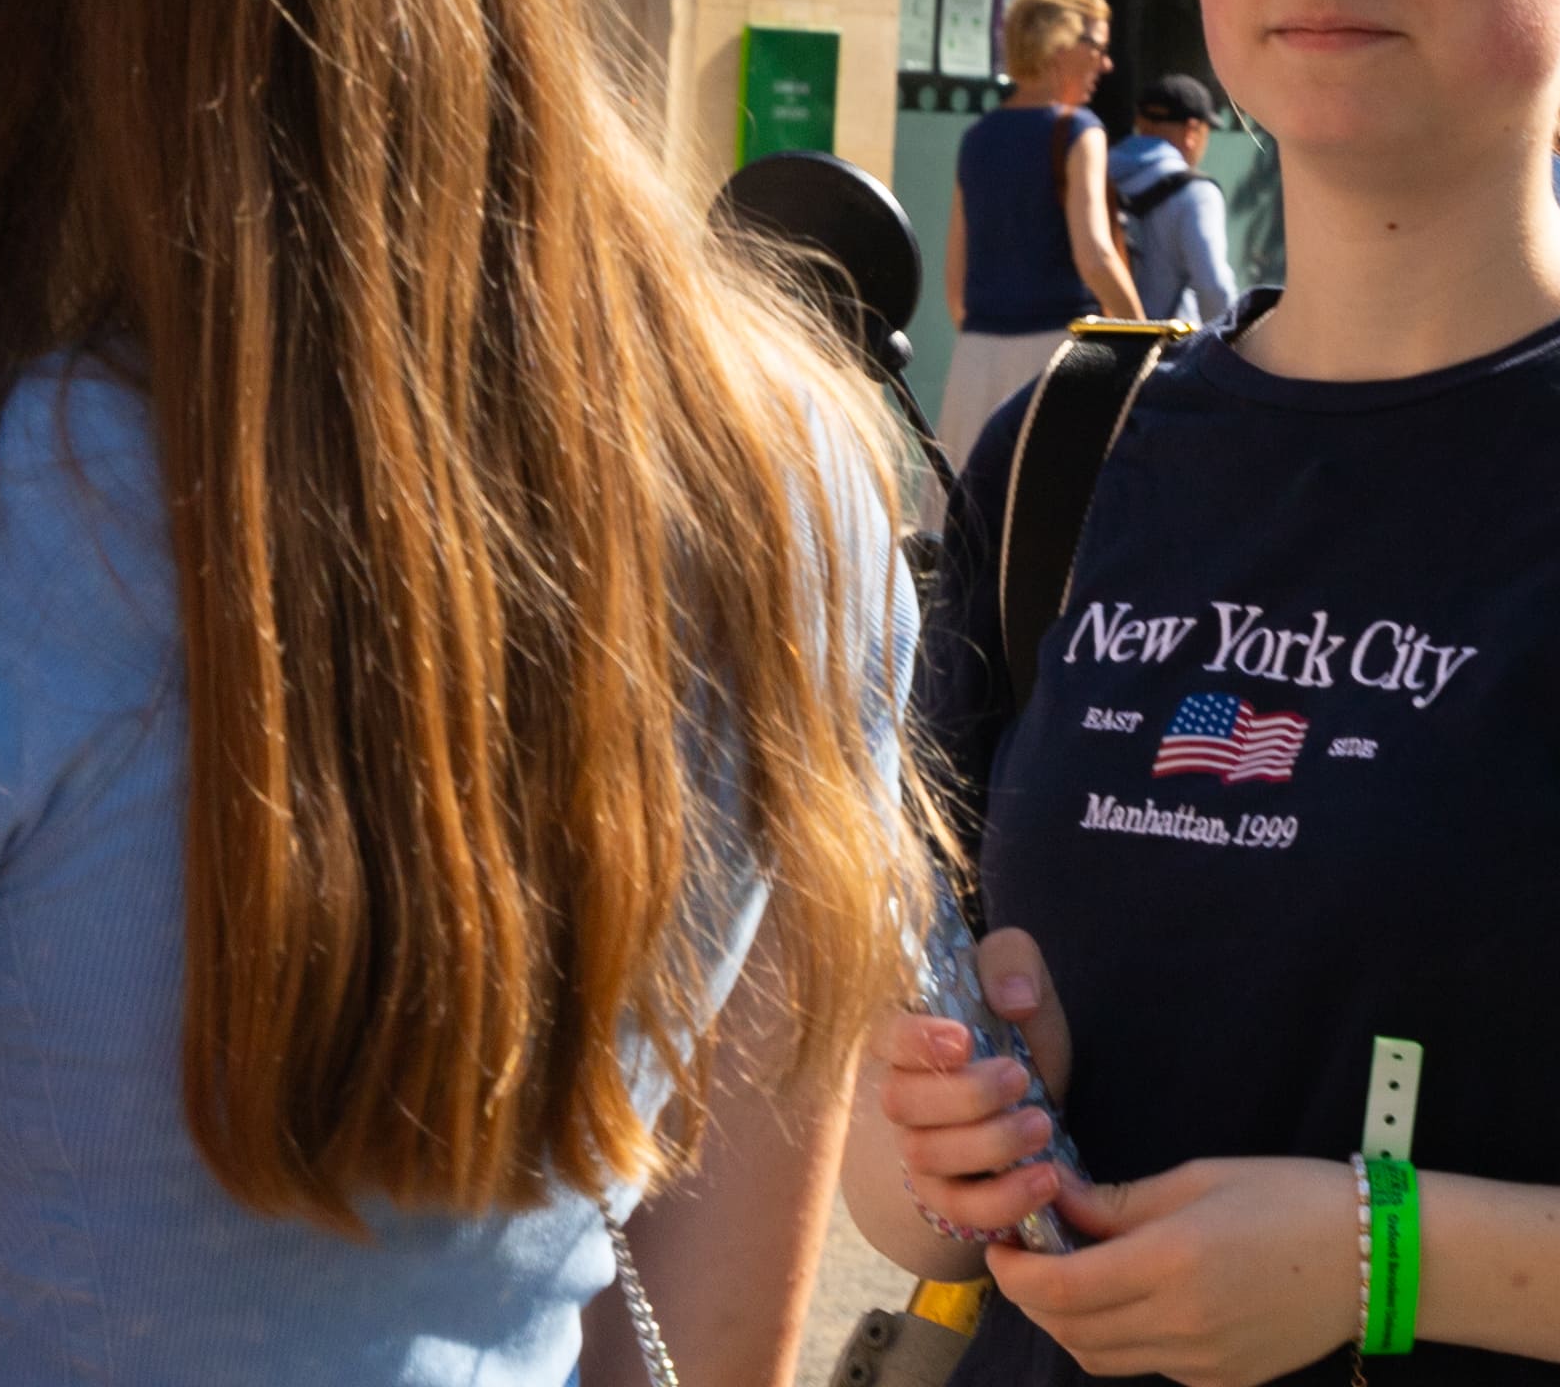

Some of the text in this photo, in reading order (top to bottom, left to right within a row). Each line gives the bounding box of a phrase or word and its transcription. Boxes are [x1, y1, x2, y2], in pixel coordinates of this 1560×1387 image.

[1064, 600, 1478, 709] New York City
[1081, 706, 1144, 733] EAST
[1232, 812, 1299, 849] 1999
